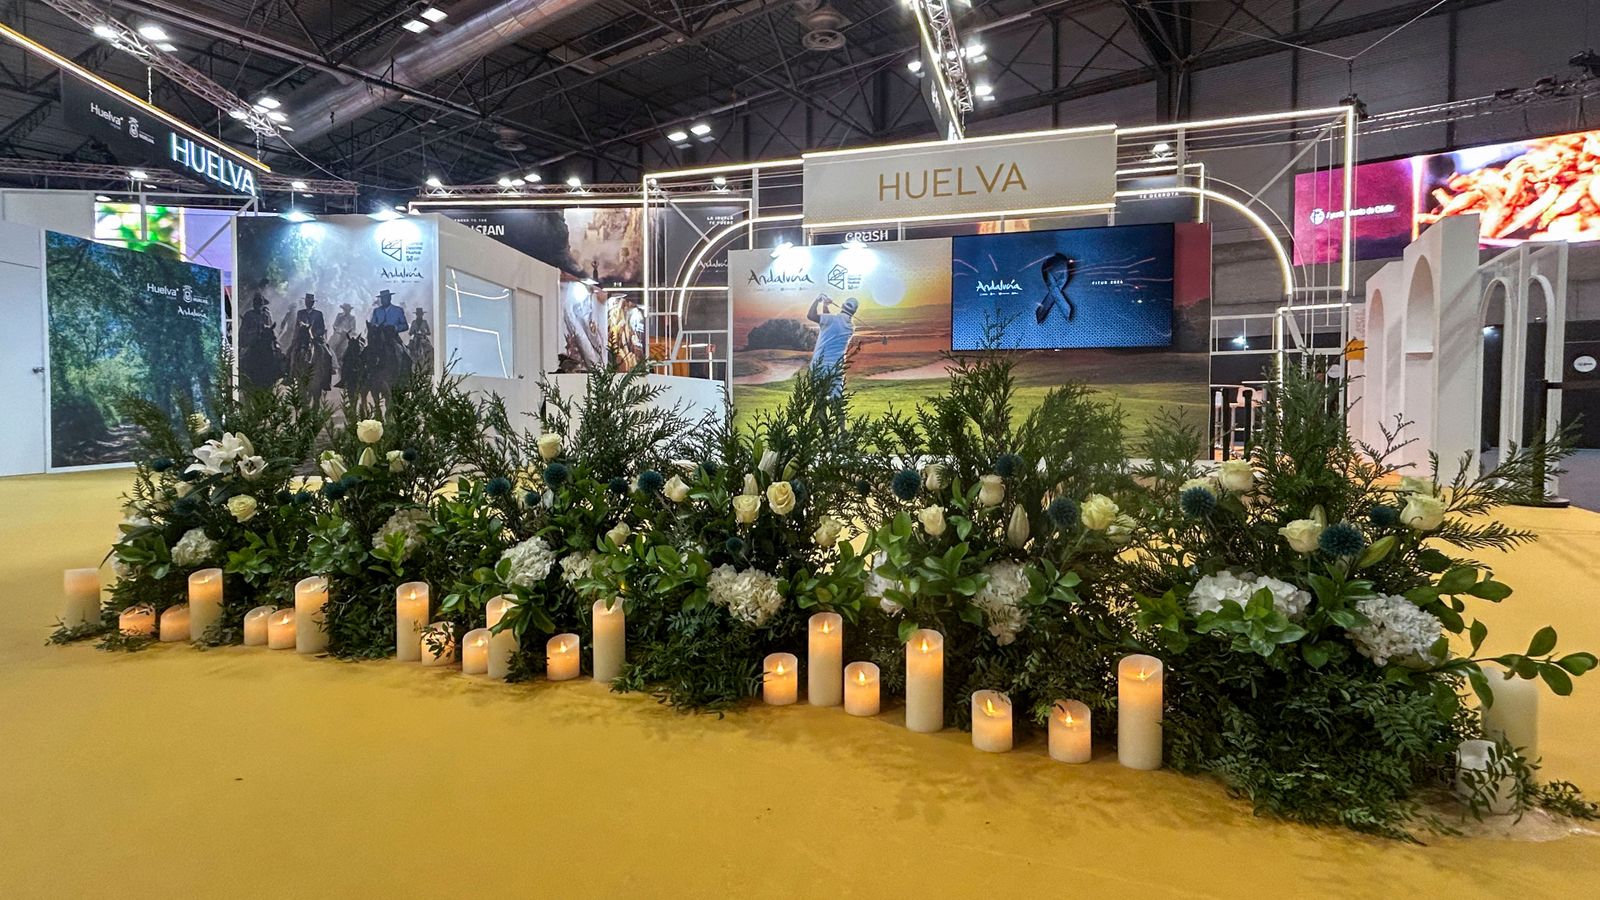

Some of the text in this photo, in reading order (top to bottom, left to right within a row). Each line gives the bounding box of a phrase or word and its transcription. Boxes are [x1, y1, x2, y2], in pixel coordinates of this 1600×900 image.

[90, 102, 123, 126] Huelva
[171, 131, 256, 197] HUELVA
[879, 162, 1028, 201] HUELVA
[845, 230, 889, 242] CRUSH
[698, 259, 728, 269] Andalucí
[380, 266, 424, 279] Andalucía
[747, 267, 815, 287] Andalucía
[147, 283, 178, 296] Huelva
[976, 279, 1023, 292] Andalucía
